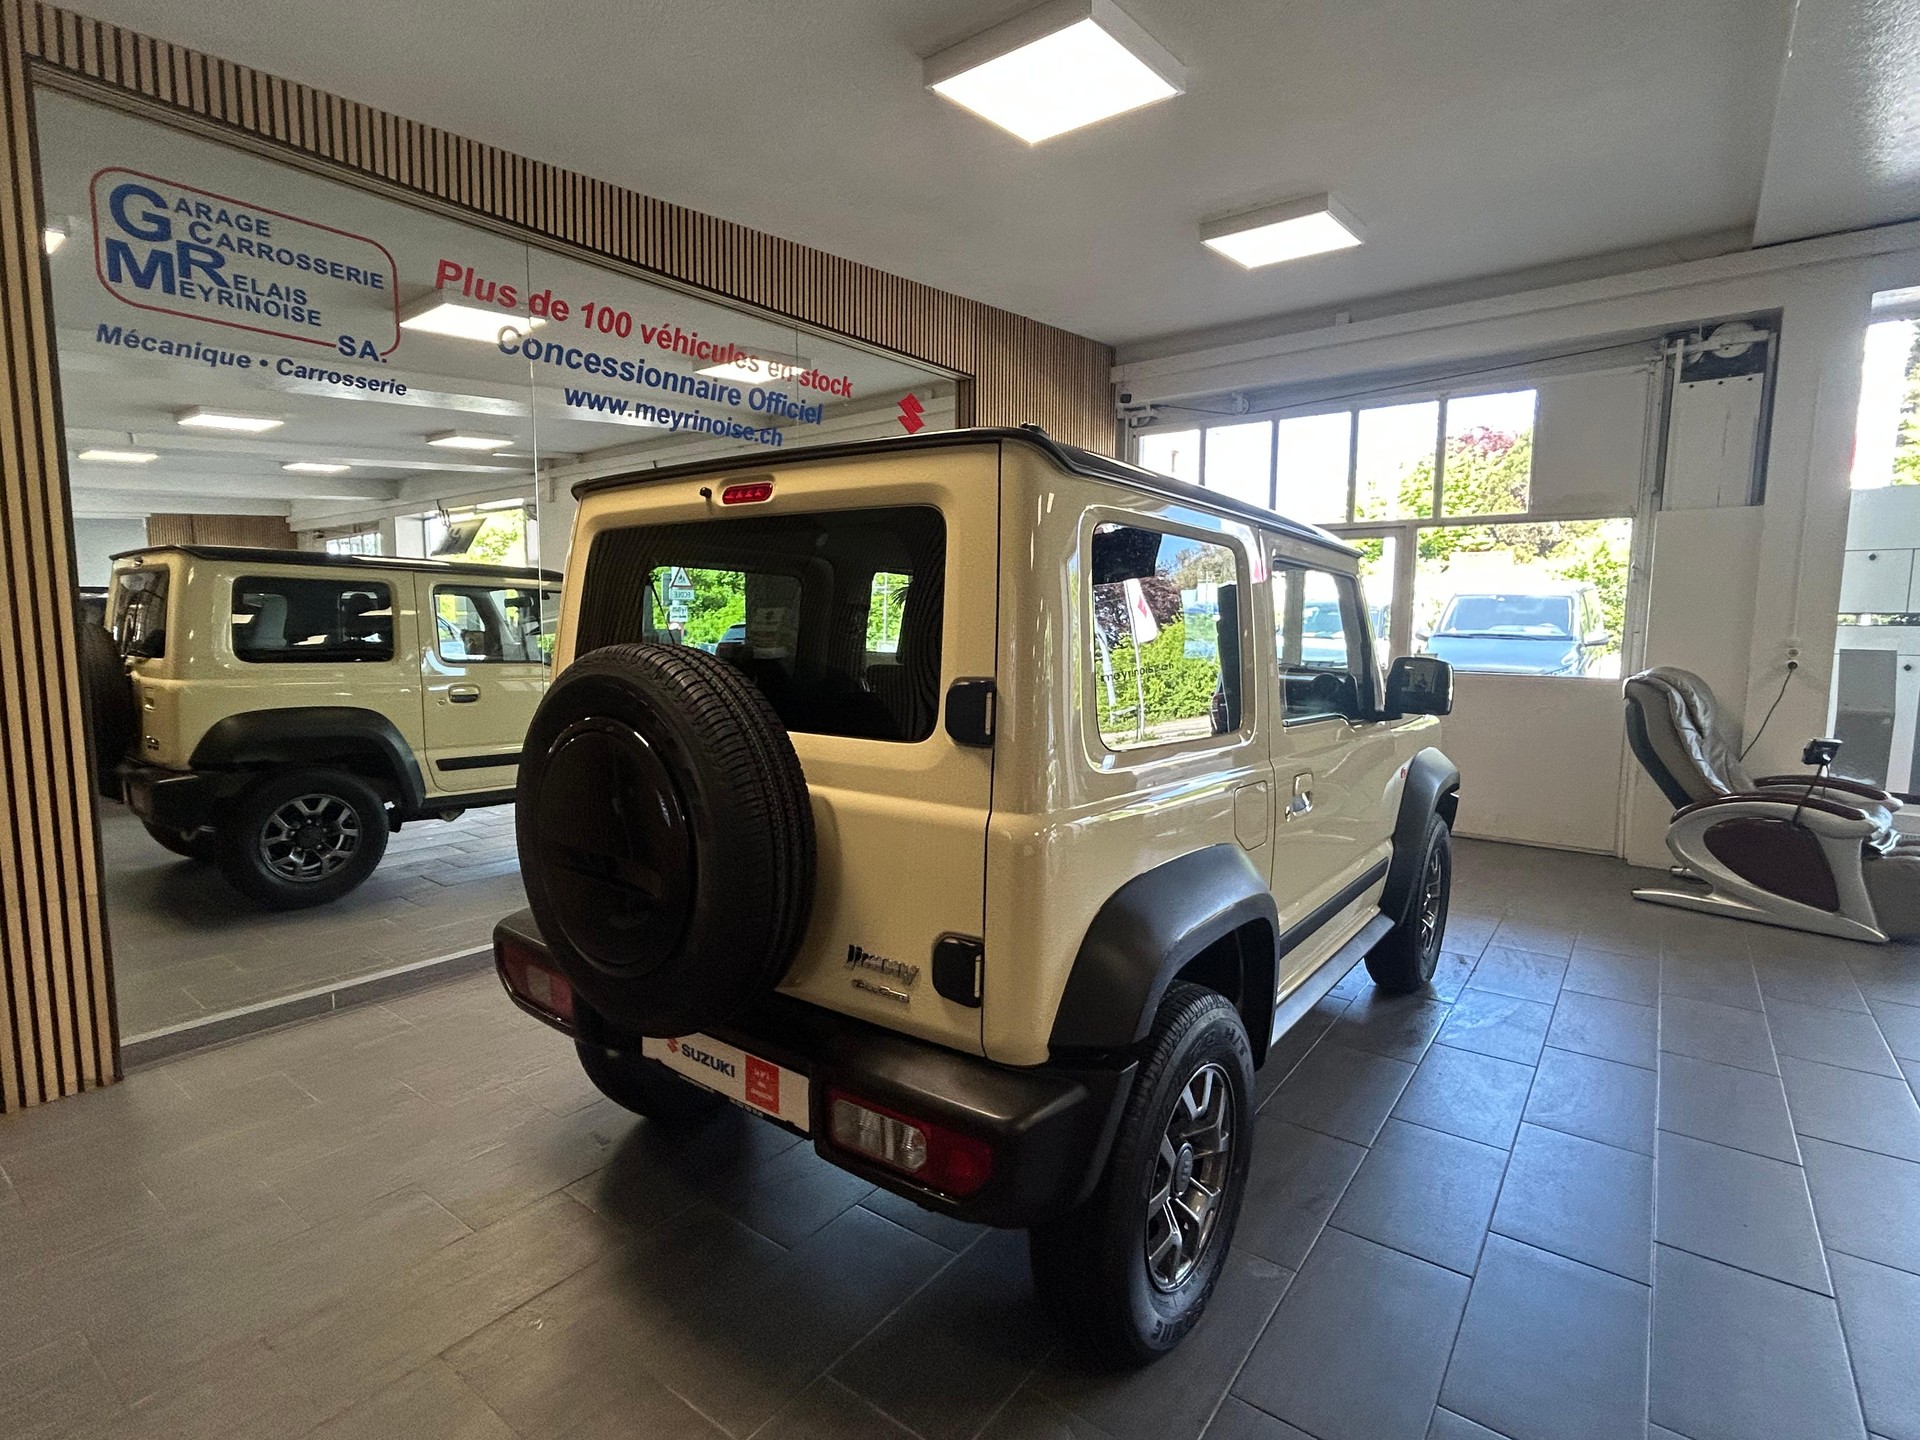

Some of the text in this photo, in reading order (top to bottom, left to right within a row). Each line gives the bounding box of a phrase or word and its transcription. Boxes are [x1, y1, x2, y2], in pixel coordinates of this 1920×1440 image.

[109, 183, 272, 242] GARAGE
[105, 237, 322, 327] MEYRINOISE
[176, 239, 308, 306] RELAIS
[188, 221, 384, 289] CARROSSERIE
[96, 324, 408, 397] Mécanique Carrosserie
[435, 259, 854, 398] Plus de 100 véhicules en stock
[497, 325, 824, 425] Concessionnaire Officiel
[564, 387, 784, 447] www.meyrinoise.ch
[681, 1043, 736, 1078] SUZUKI
